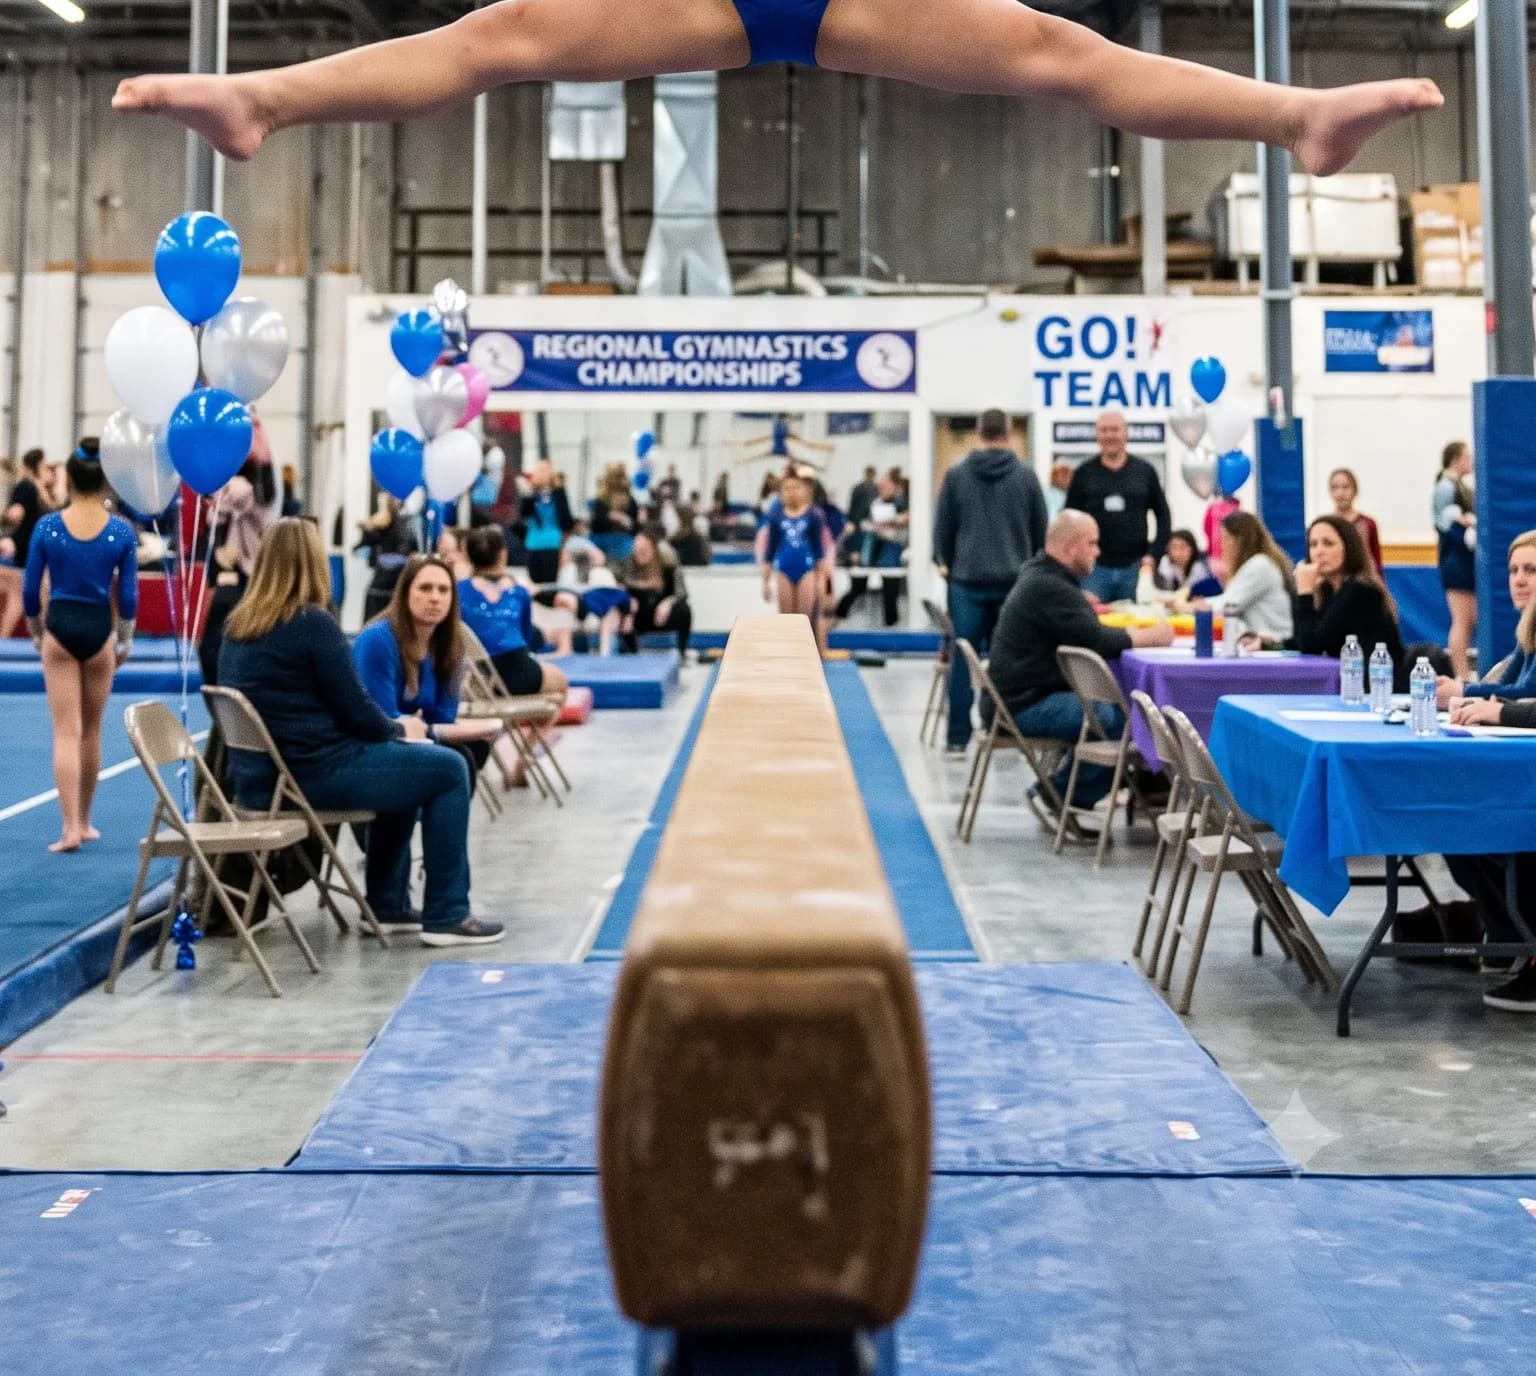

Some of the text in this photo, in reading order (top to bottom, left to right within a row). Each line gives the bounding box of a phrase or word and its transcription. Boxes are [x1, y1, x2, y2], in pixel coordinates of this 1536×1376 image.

[533, 334, 848, 361] REGIONAL GYMNASTICS
[1036, 316, 1136, 360] GO!
[577, 360, 802, 387] CHAMPIONSHIPS
[1034, 371, 1172, 407] TEAM
